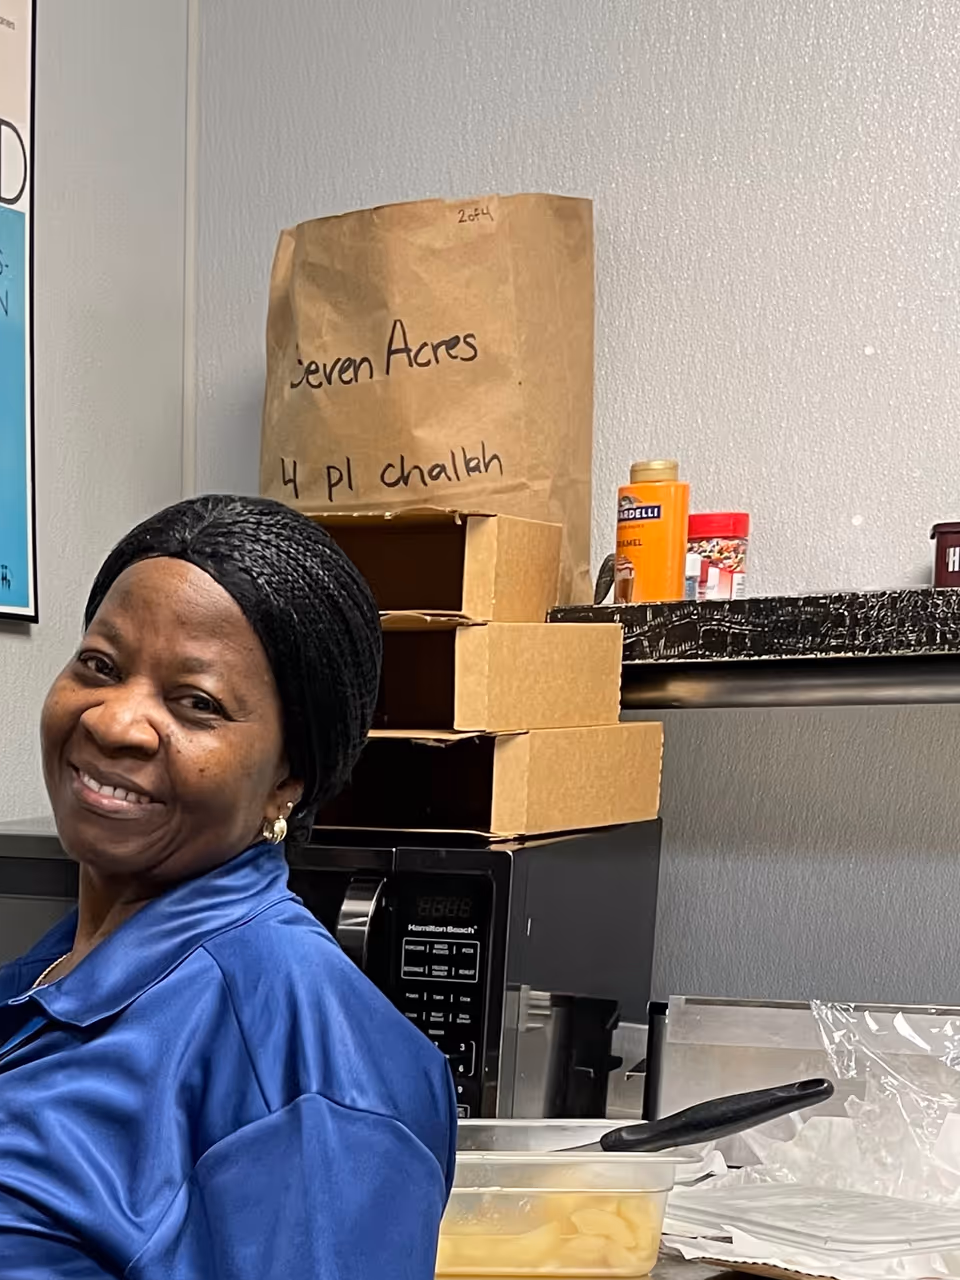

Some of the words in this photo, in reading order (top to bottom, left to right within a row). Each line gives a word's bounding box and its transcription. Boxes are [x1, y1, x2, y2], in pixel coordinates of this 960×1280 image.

[386, 319, 479, 375] Acres
[281, 457, 299, 499] 4
[380, 441, 503, 489] challah
[408, 924, 446, 933] Hamilton
[447, 926, 474, 934] Beach
[460, 1043, 465, 1051] 3
[458, 1064, 464, 1072] 6
